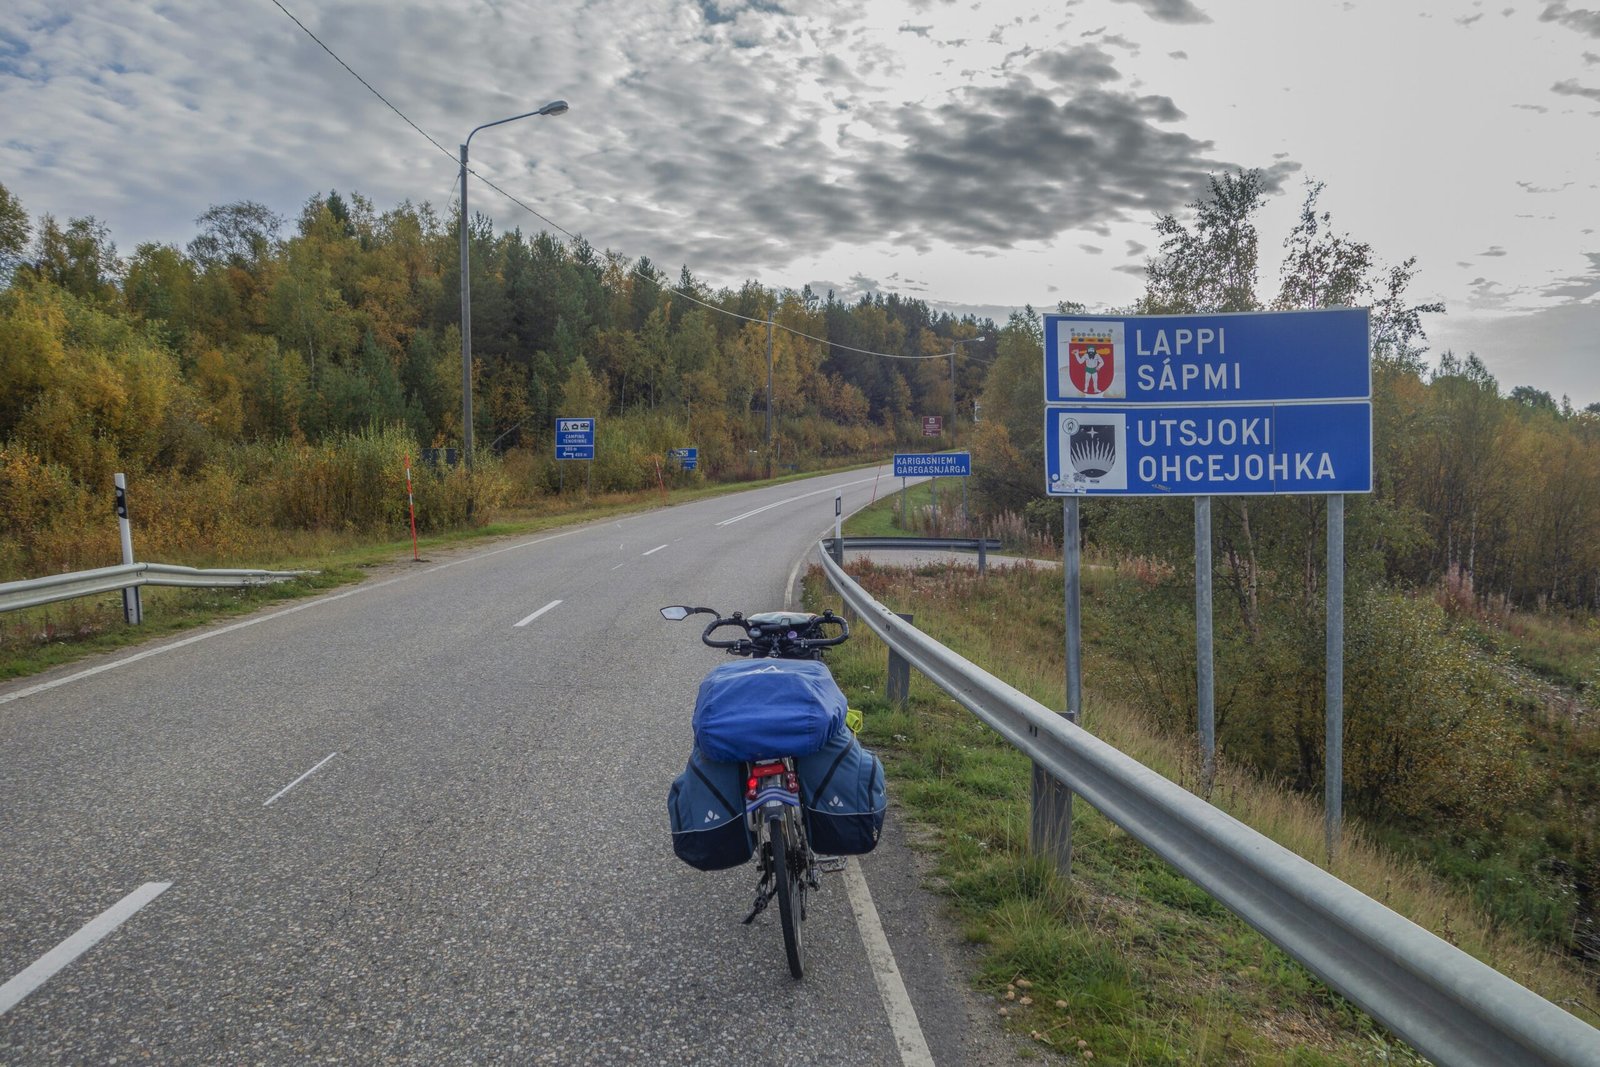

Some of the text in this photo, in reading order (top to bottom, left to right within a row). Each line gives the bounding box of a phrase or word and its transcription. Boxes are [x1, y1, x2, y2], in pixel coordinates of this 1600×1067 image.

[1136, 327, 1225, 356] LAPPI
[1137, 358, 1241, 391] SÁPMI
[1138, 417, 1270, 447] UTSJOKI
[896, 457, 956, 465] KARIGASNIEMI
[1138, 452, 1336, 482] OHCEJOHKA
